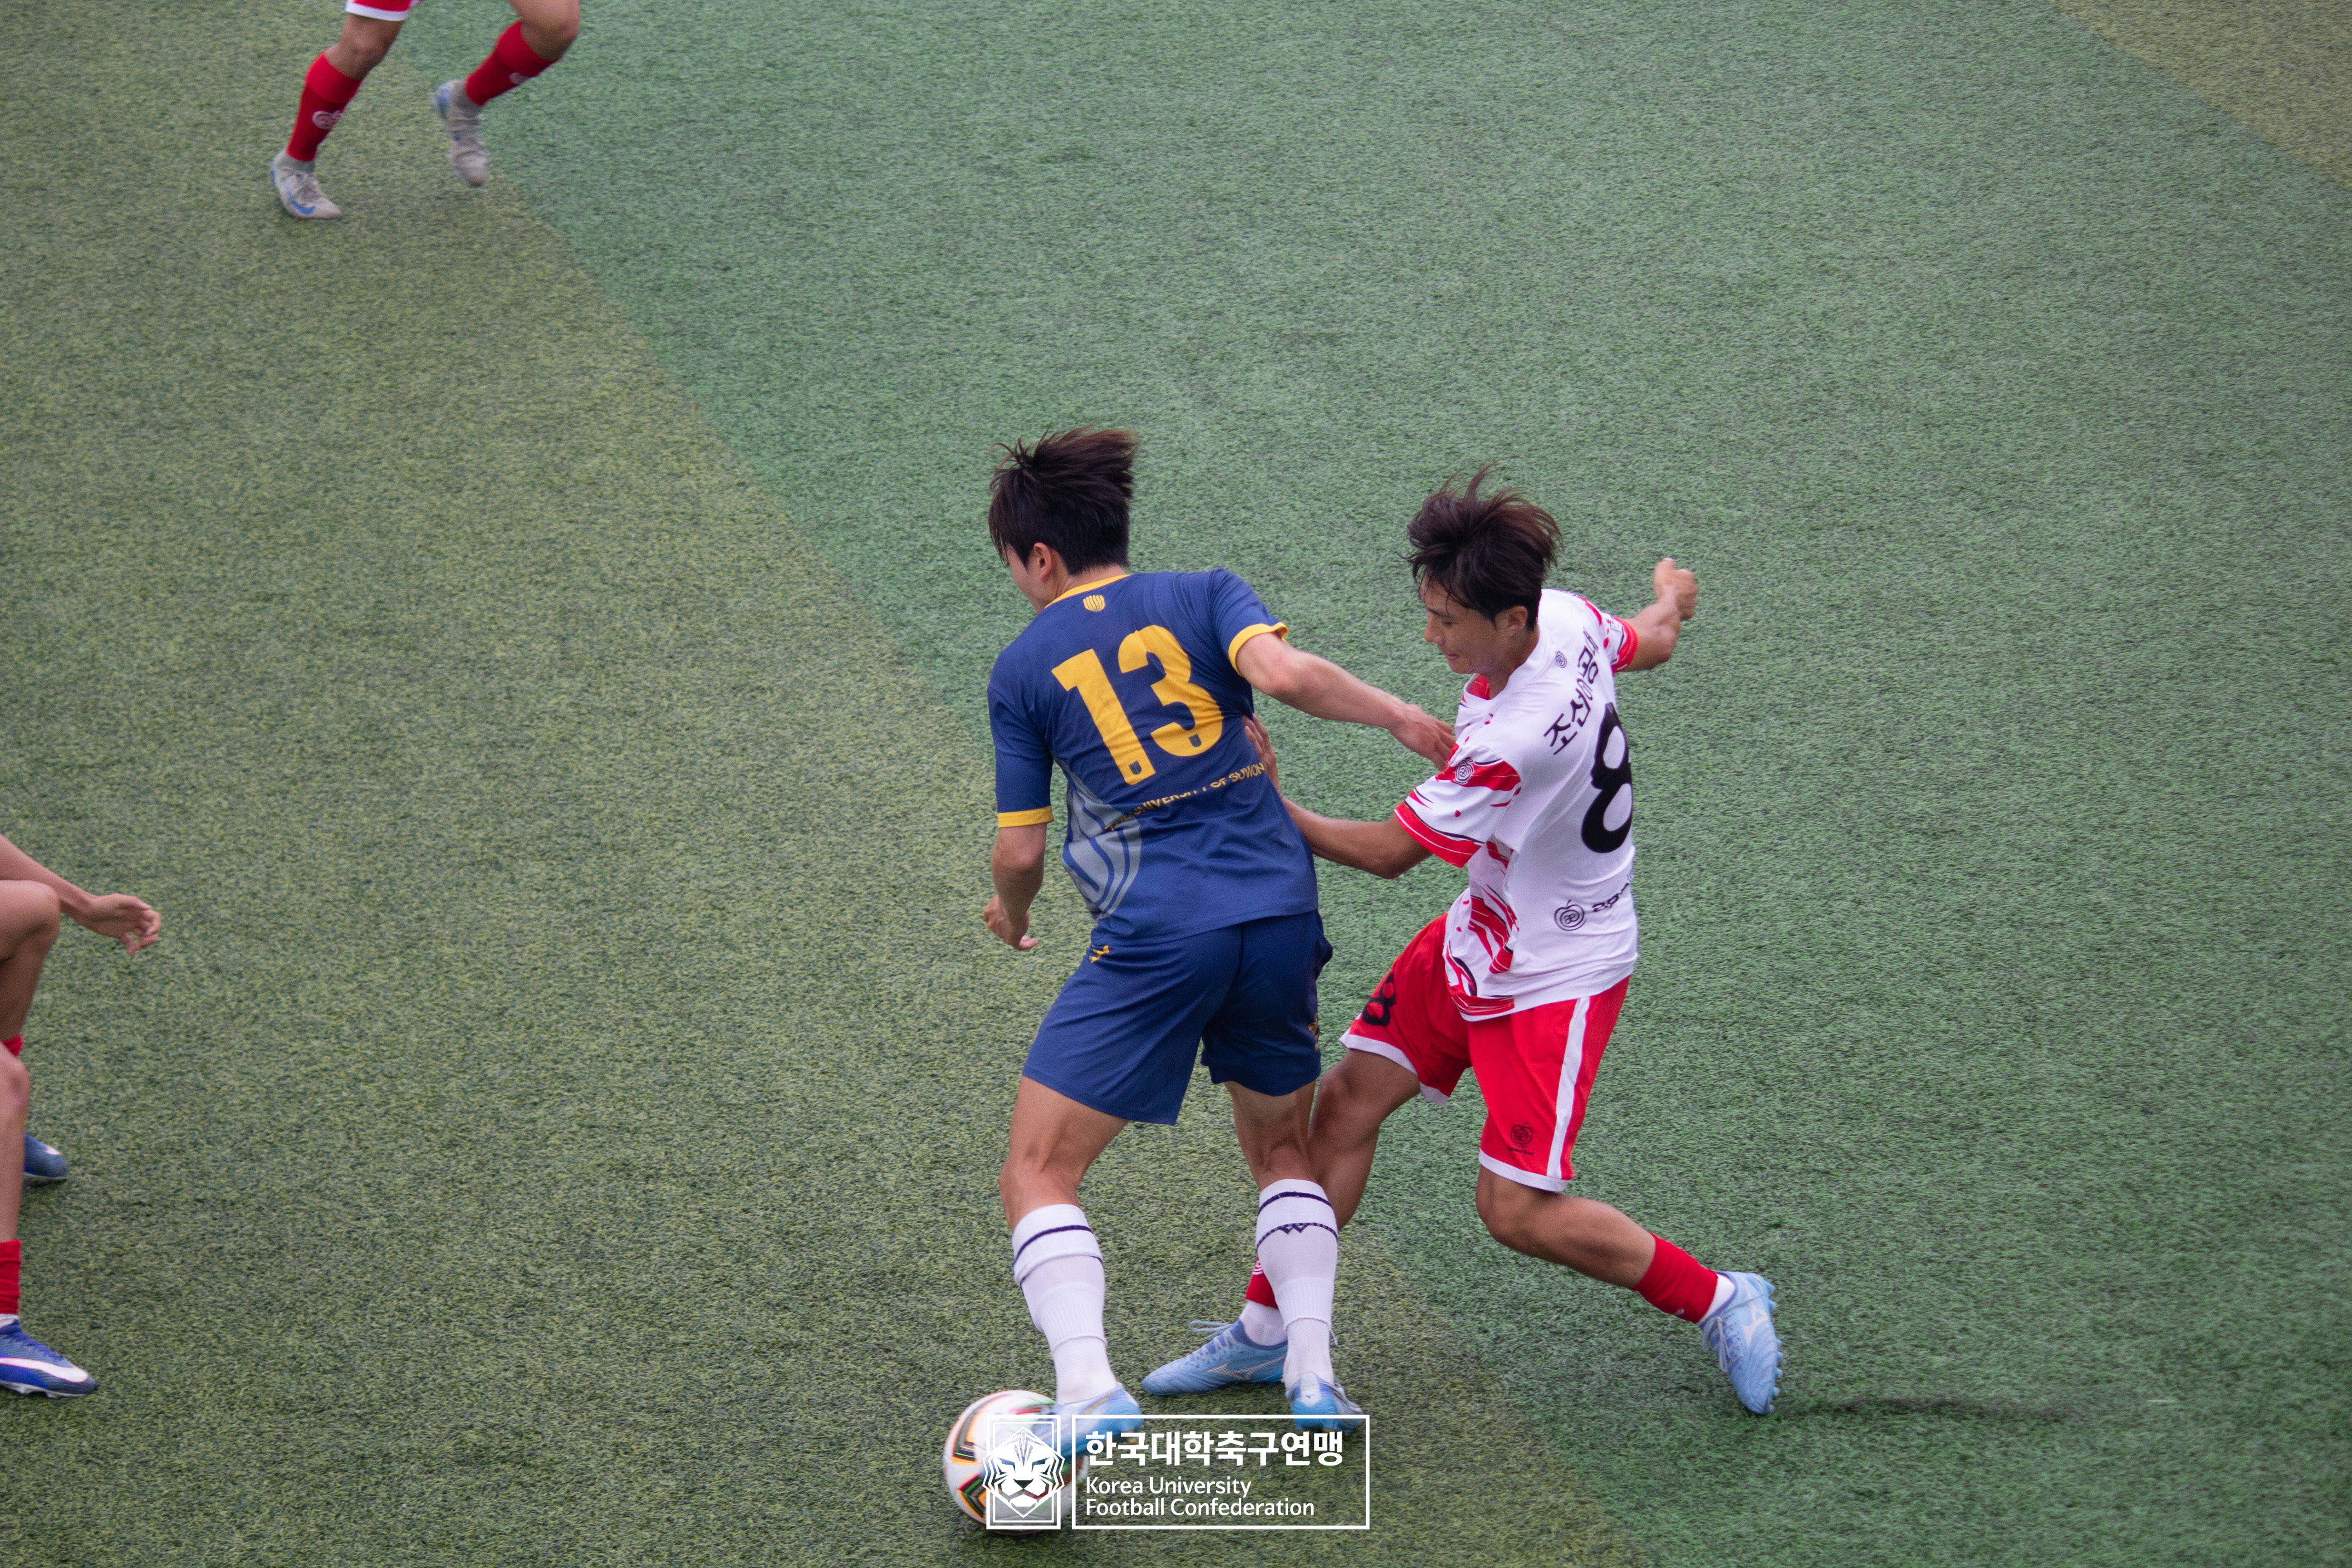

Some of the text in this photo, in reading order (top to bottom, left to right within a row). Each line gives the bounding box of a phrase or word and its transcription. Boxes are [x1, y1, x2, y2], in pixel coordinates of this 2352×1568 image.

[1051, 625, 1224, 785] 13
[1210, 777, 1226, 788] OF
[1228, 762, 1265, 782] SUWON
[1581, 702, 1632, 853] 8
[1362, 972, 1396, 1028] 8
